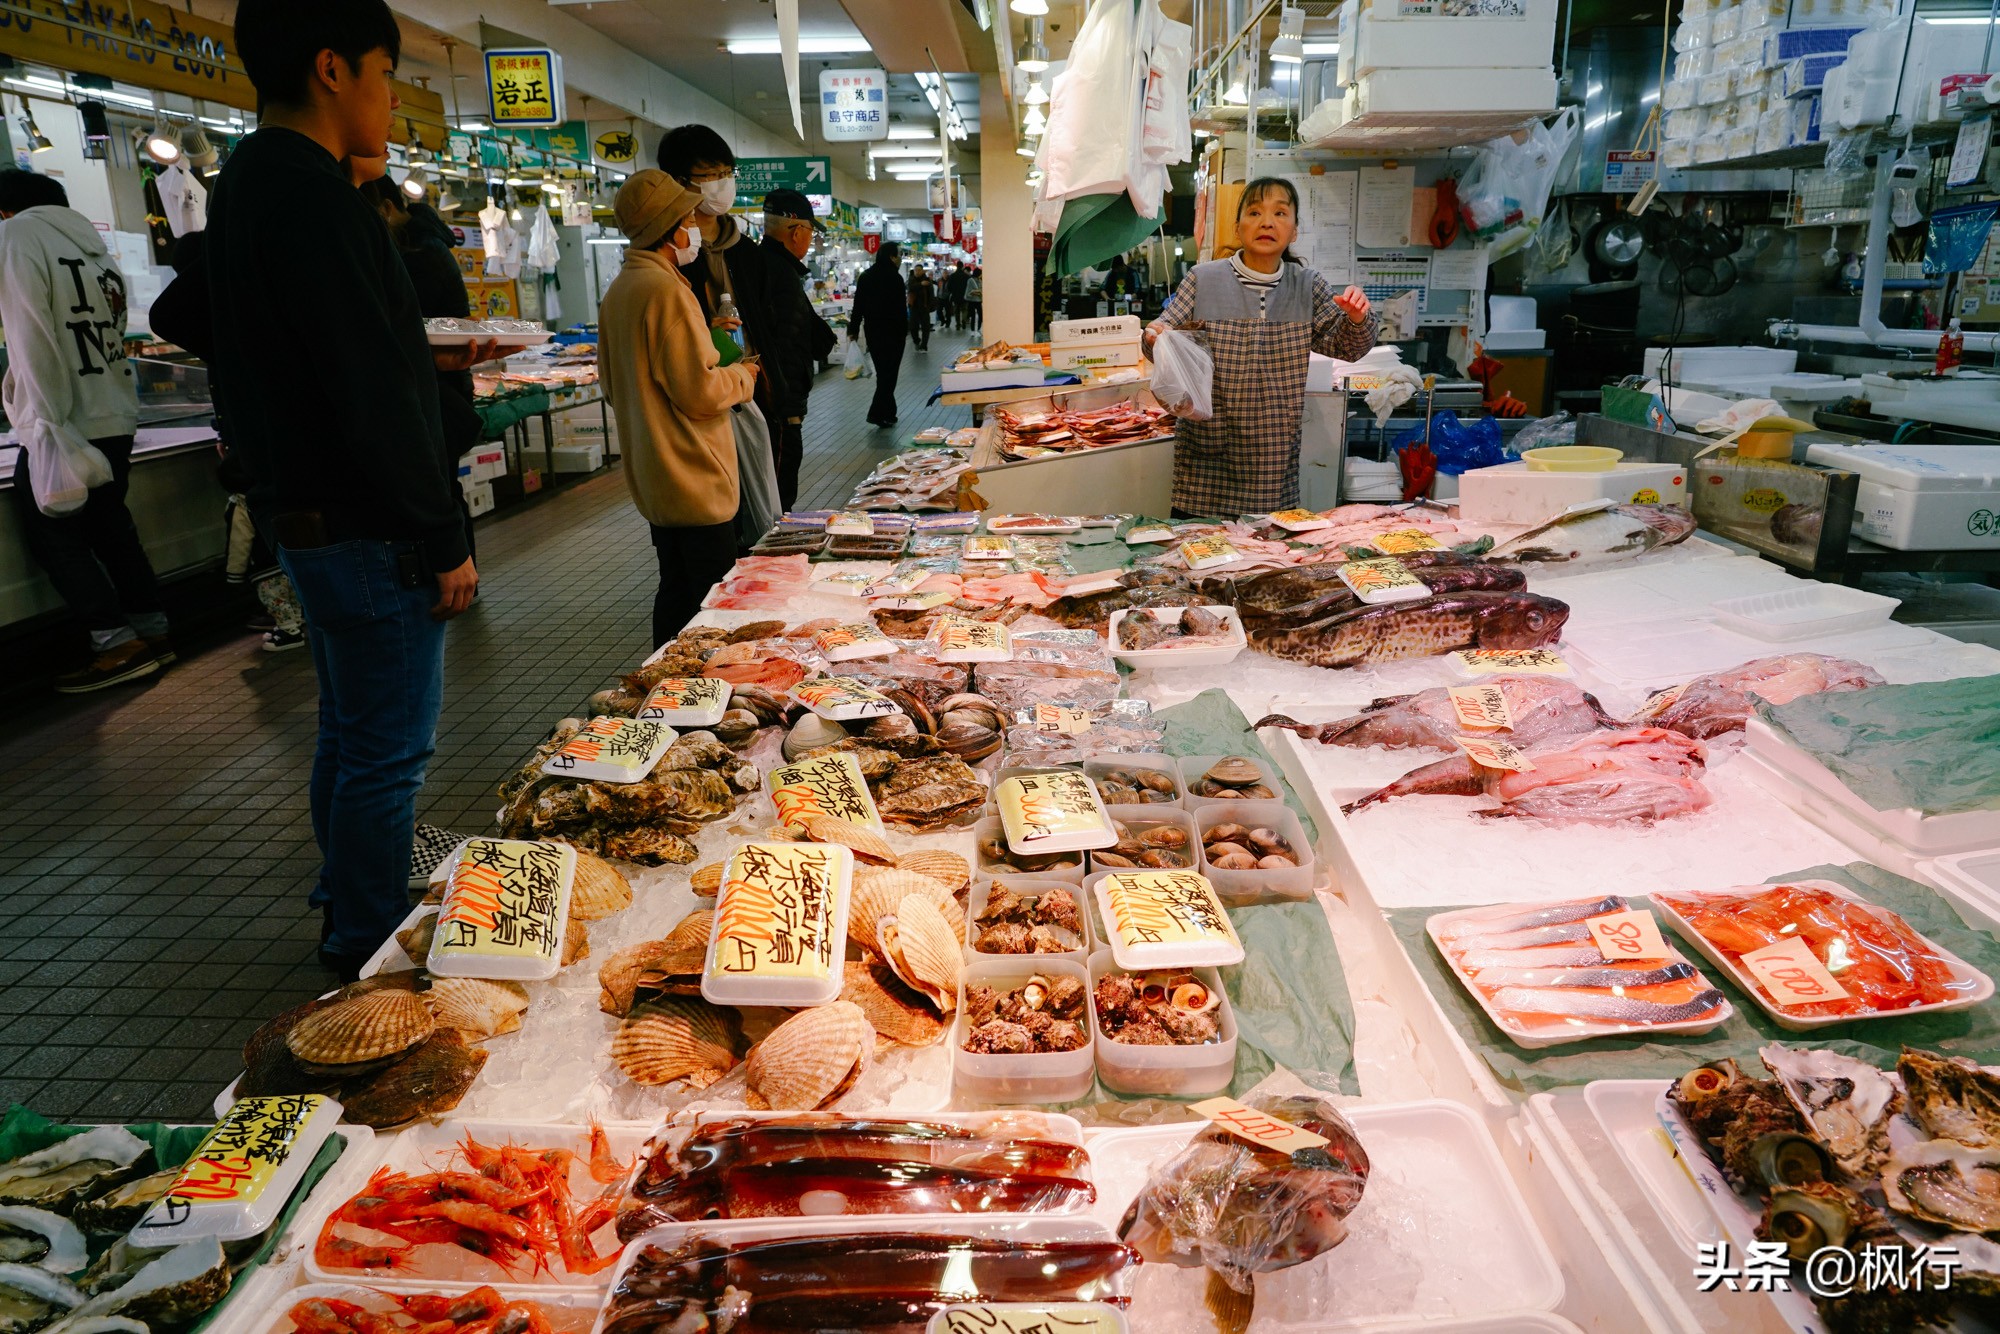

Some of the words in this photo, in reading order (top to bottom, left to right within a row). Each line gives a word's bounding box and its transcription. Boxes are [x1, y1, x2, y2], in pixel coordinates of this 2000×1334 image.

[495, 58, 542, 70] 高級鮮魚
[495, 79, 548, 105] 岩正
[511, 108, 546, 116] 28-9380
[829, 110, 880, 122] 島守商店
[795, 183, 807, 191] 2F
[58, 257, 95, 314] I
[817, 757, 870, 821] 岩手県産
[1065, 772, 1098, 815] 千葉県産
[491, 852, 530, 946] ホタテ貝
[519, 842, 563, 957] 北海道産
[767, 856, 801, 964] ホタテ貝
[794, 848, 835, 968] 北海道産
[1139, 879, 1189, 933] サザエ
[1600, 922, 1644, 953] 800
